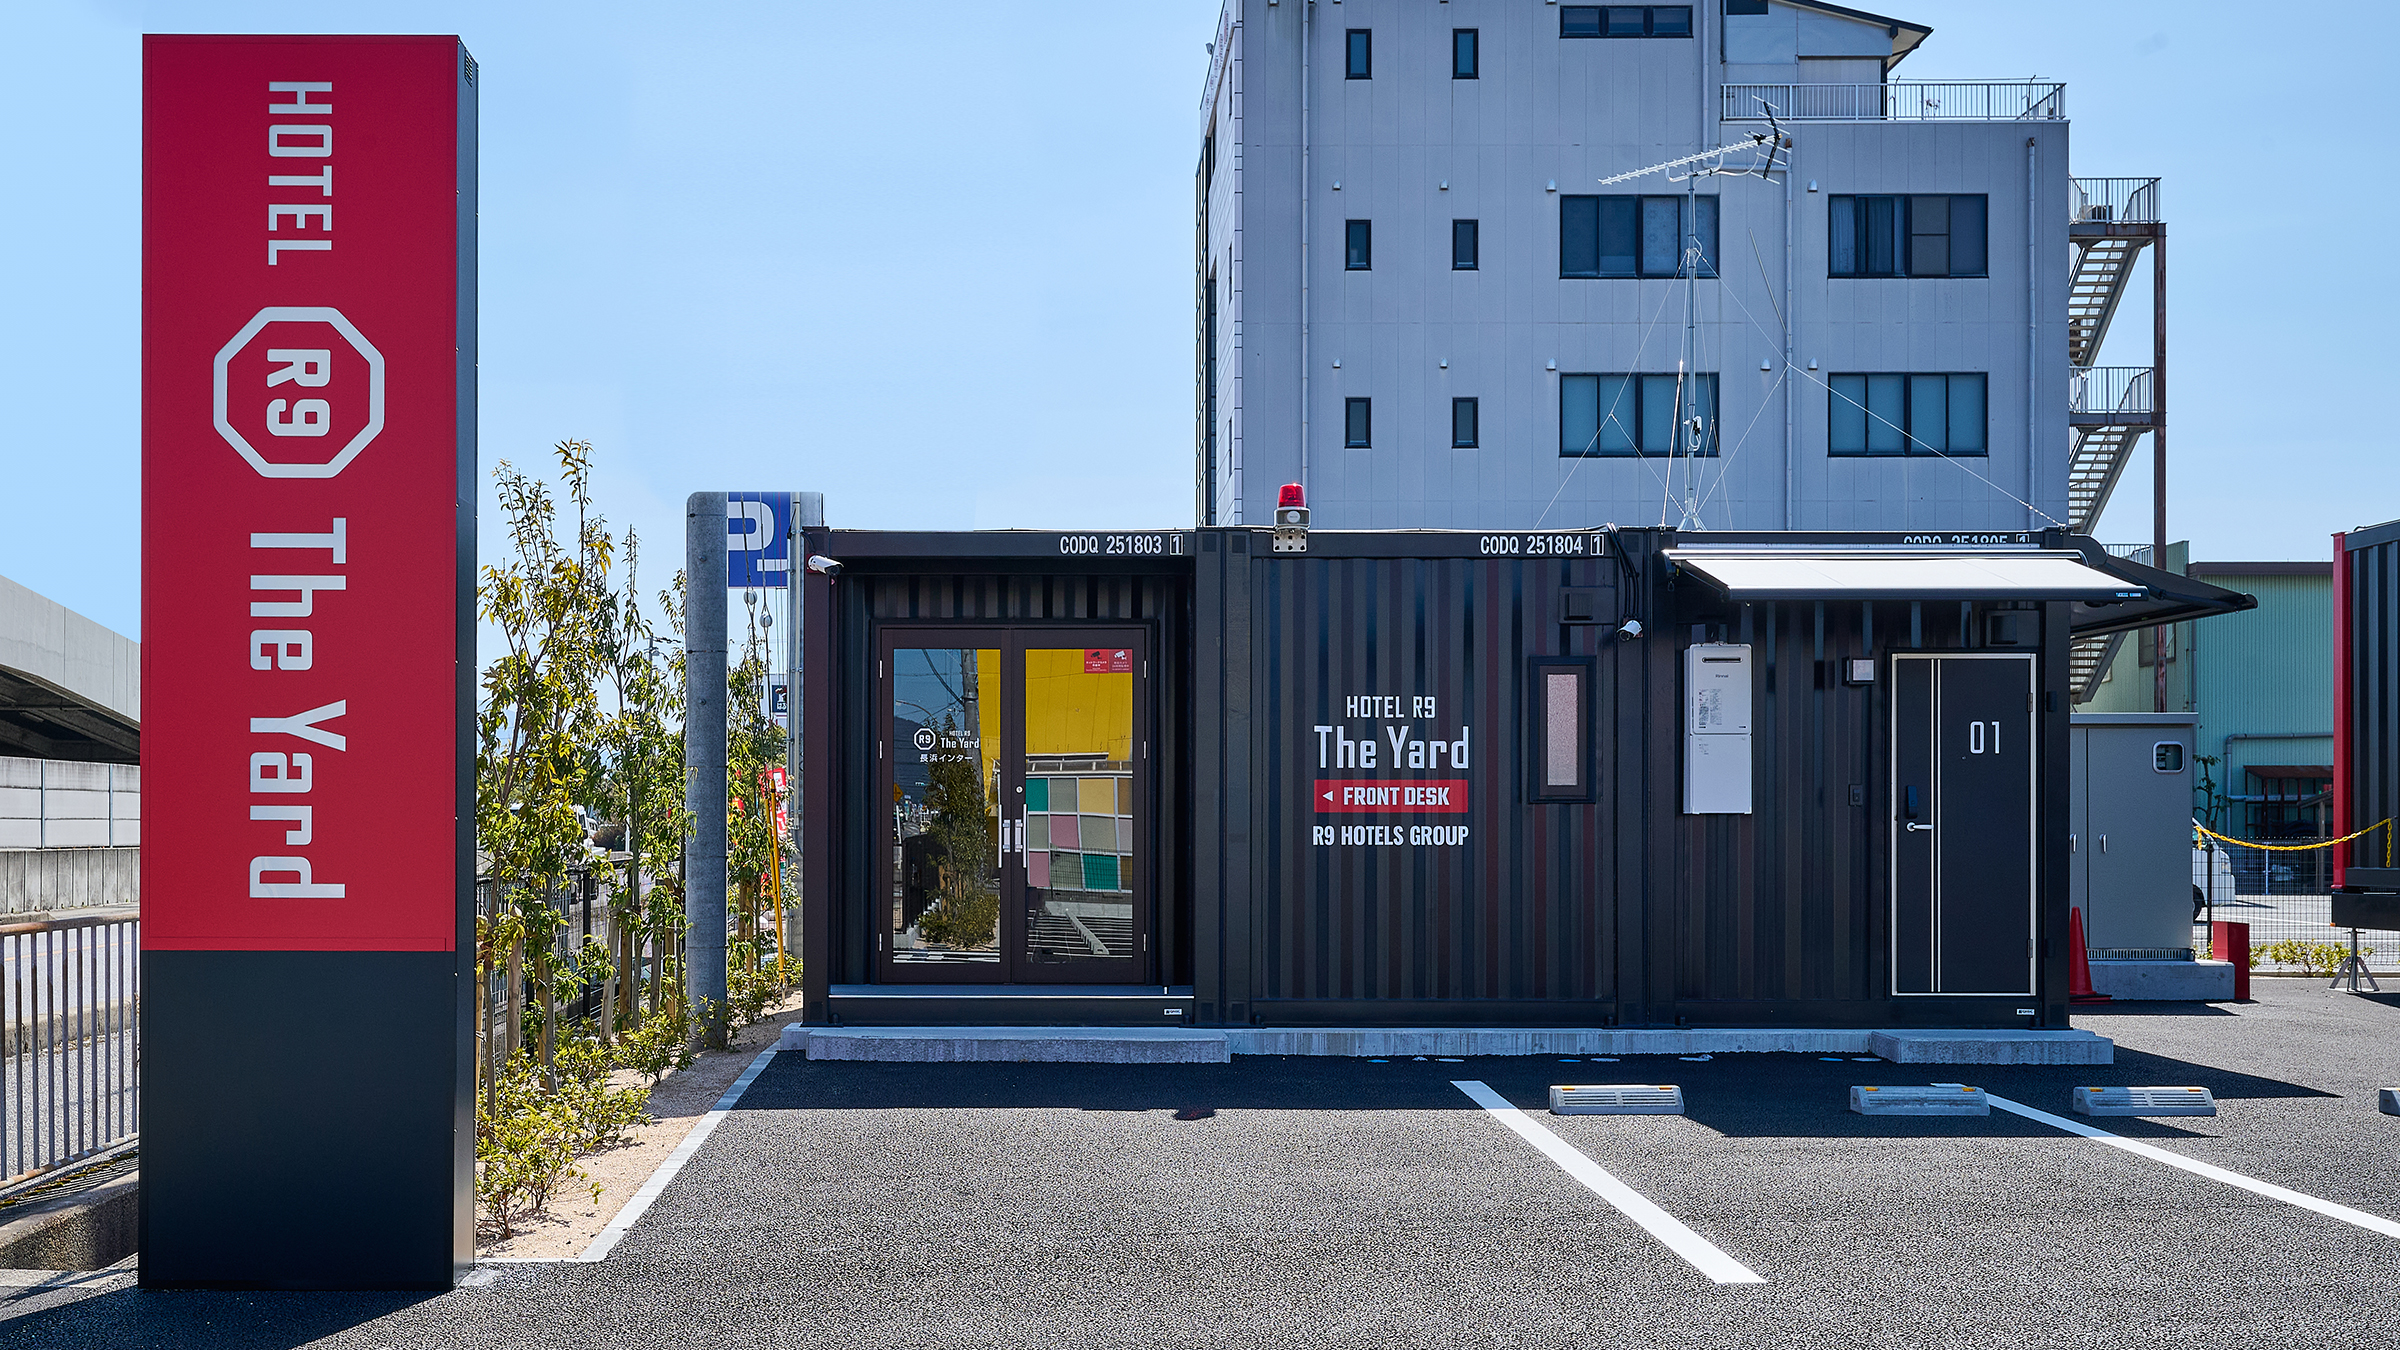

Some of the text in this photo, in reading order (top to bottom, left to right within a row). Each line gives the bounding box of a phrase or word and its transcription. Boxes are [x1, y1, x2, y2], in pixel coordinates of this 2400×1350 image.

[249, 81, 347, 899] HOTEL R9 The Yard
[1060, 534, 1182, 554] CODQ 251803 1
[1480, 535, 1602, 555] CODQ 251804 1
[1346, 695, 1436, 719] HOTEL R9
[918, 734, 931, 744] R9
[940, 737, 980, 749] The Yard
[1313, 725, 1469, 769] The Yard
[1970, 721, 2000, 754] 01
[919, 753, 973, 763] 長浜インター
[1343, 786, 1450, 806] FRONT DESK
[1312, 825, 1469, 846] R9 HOTELS GROUP
